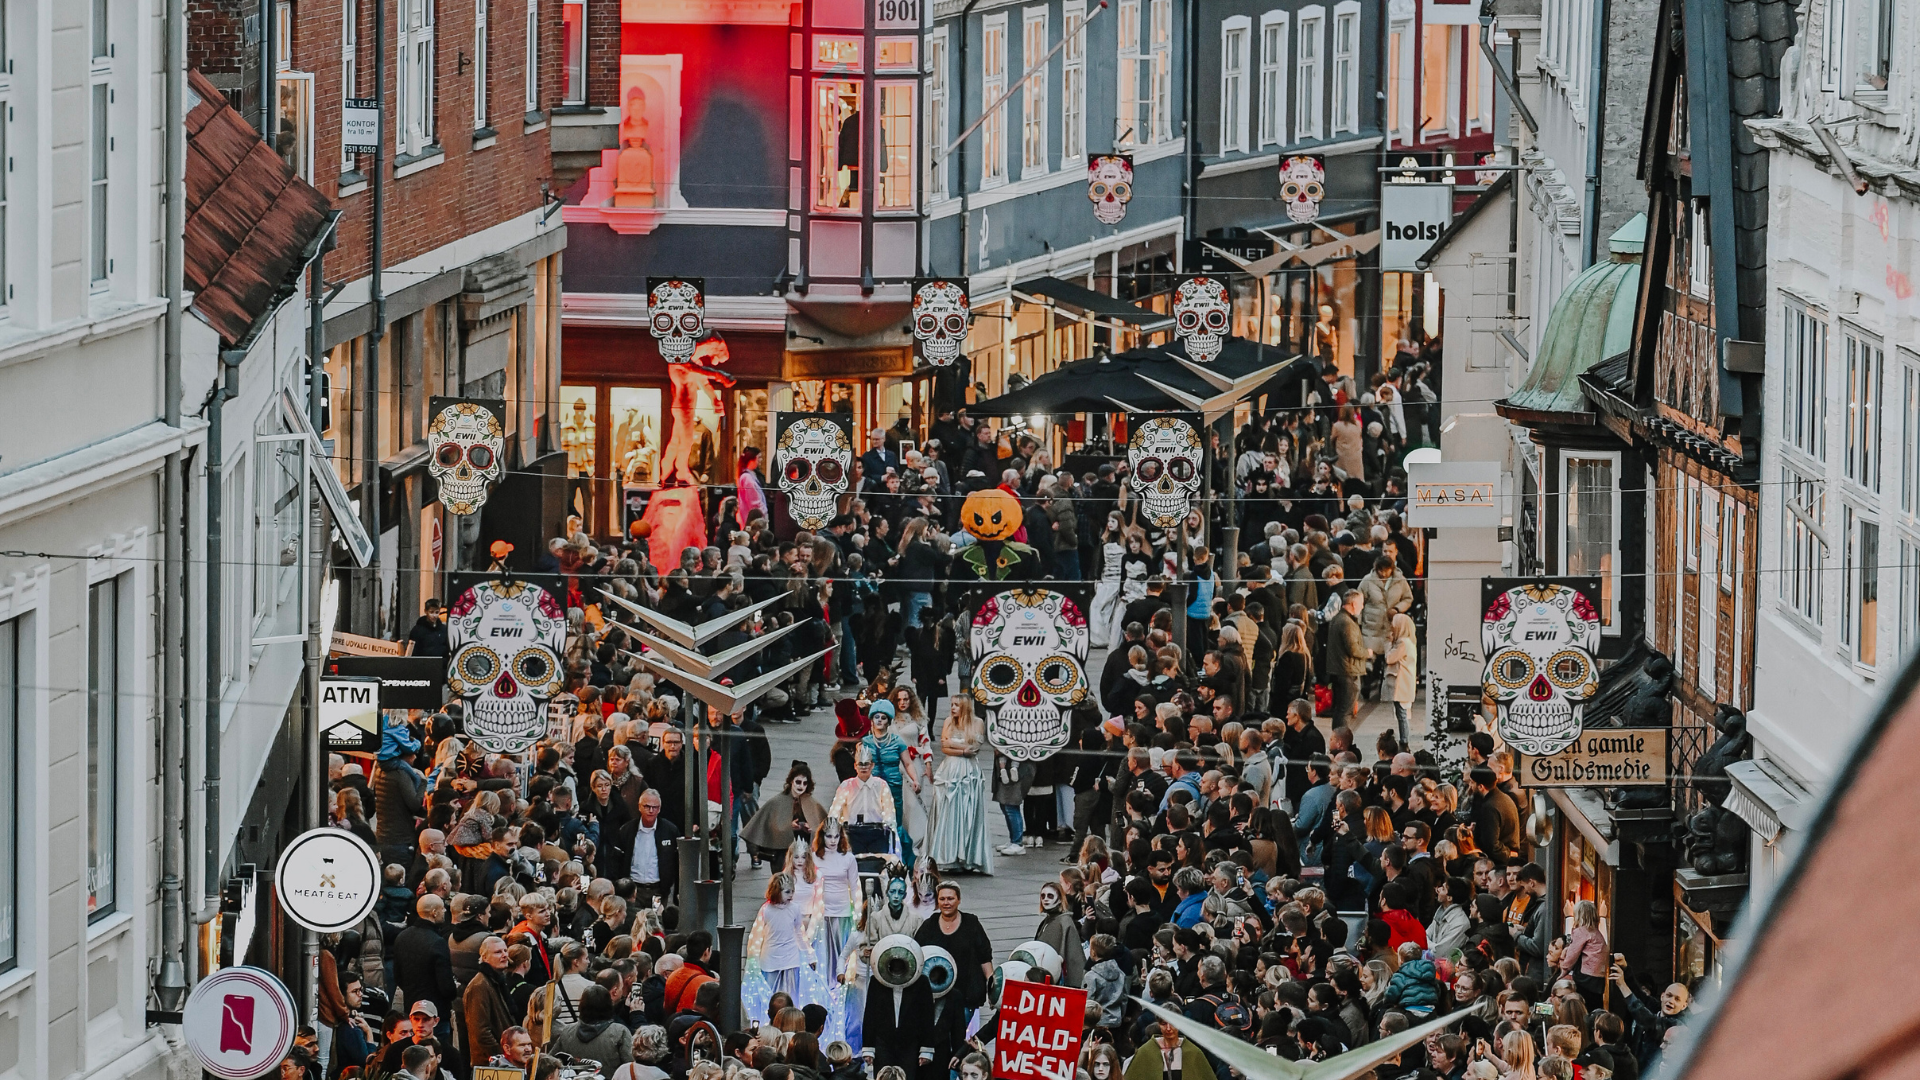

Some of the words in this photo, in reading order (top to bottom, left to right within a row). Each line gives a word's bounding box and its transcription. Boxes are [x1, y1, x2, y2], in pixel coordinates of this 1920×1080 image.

[878, 0, 917, 21] 1901
[358, 100, 377, 108] LEJE
[346, 120, 376, 128] KONTOR
[359, 146, 377, 154] 5050
[455, 432, 477, 441] EWII
[803, 447, 825, 455] EWII
[1154, 446, 1177, 454] EWII
[1416, 484, 1493, 503] MASAI
[490, 627, 523, 638] EWII
[1524, 630, 1558, 642] EWII
[345, 639, 367, 650] UDVALG
[1012, 635, 1046, 647] EWII
[382, 679, 430, 687] OPENHAGEN
[322, 686, 370, 704] ATM
[1587, 734, 1645, 758] gamle
[1530, 756, 1651, 782] Guldsmedie
[294, 889, 325, 898] MEAT
[327, 891, 335, 899] &
[337, 892, 359, 900] EAT
